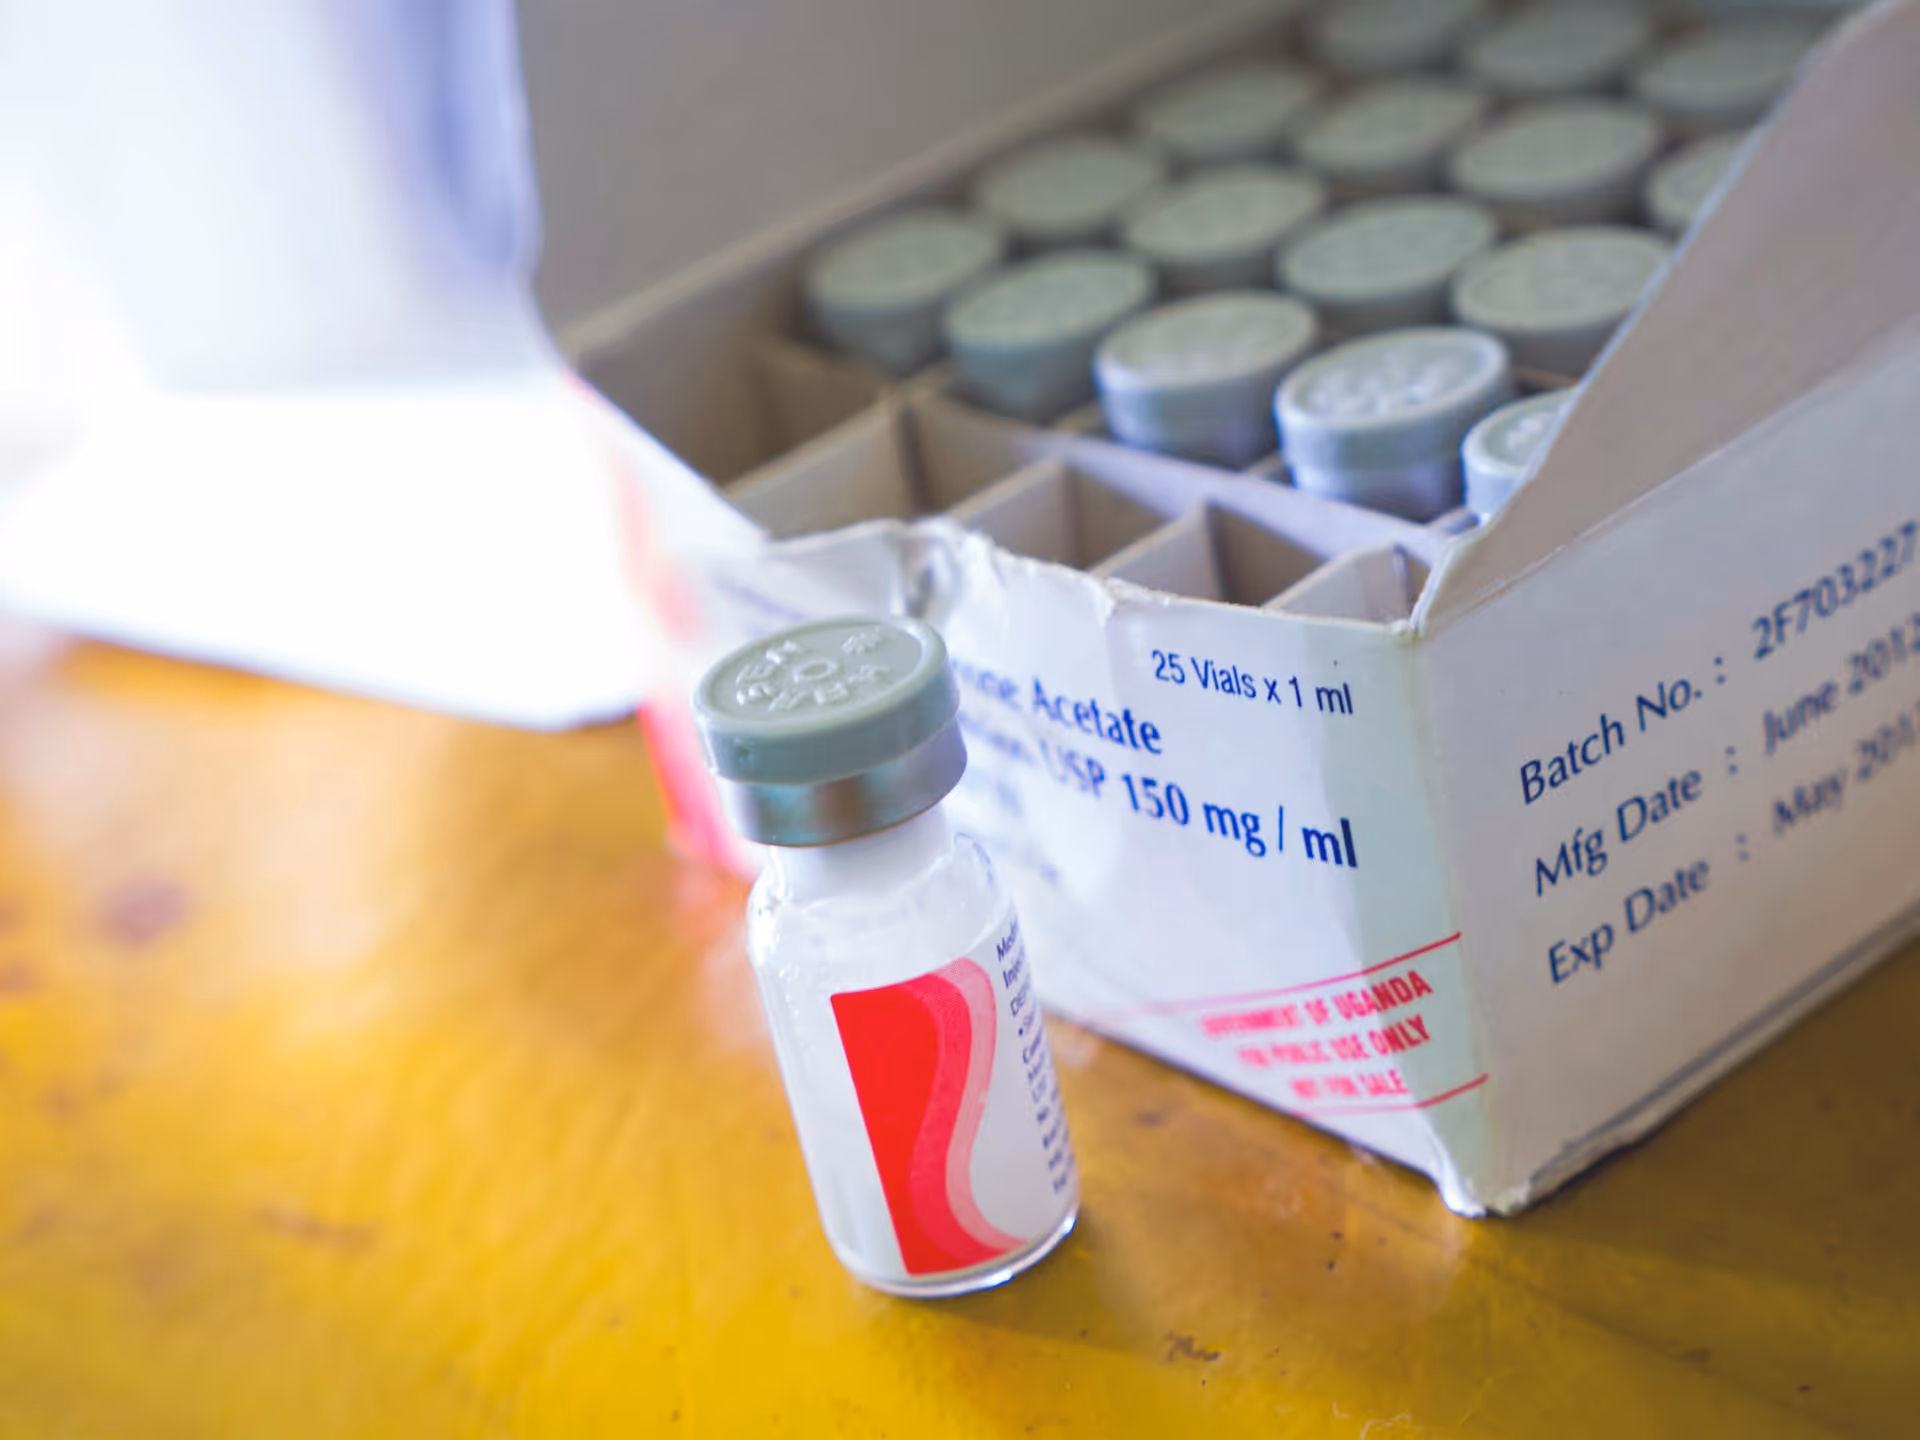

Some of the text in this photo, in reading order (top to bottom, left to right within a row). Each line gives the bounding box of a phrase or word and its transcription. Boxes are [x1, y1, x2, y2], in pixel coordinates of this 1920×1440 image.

[1033, 675, 1162, 755] Acetate
[1152, 649, 1354, 715] 25 Vials x 1 ml
[1519, 713, 1625, 804] Batch
[1636, 679, 1703, 732] No.
[1753, 520, 1918, 661] 2F703227
[1038, 736, 1106, 799] USP
[1121, 771, 1190, 826] 150
[1202, 803, 1266, 857] mg
[1301, 817, 1358, 868] ml
[1536, 827, 1608, 897] Mfg
[1616, 771, 1702, 843] Date
[1763, 680, 1838, 757] June
[1548, 924, 1614, 984] Exp
[1624, 861, 1709, 934] Date
[1773, 768, 1848, 837] May
[1857, 703, 1920, 782] 201
[1332, 970, 1434, 1021] UGANDA
[1369, 1014, 1430, 1056] ONLY
